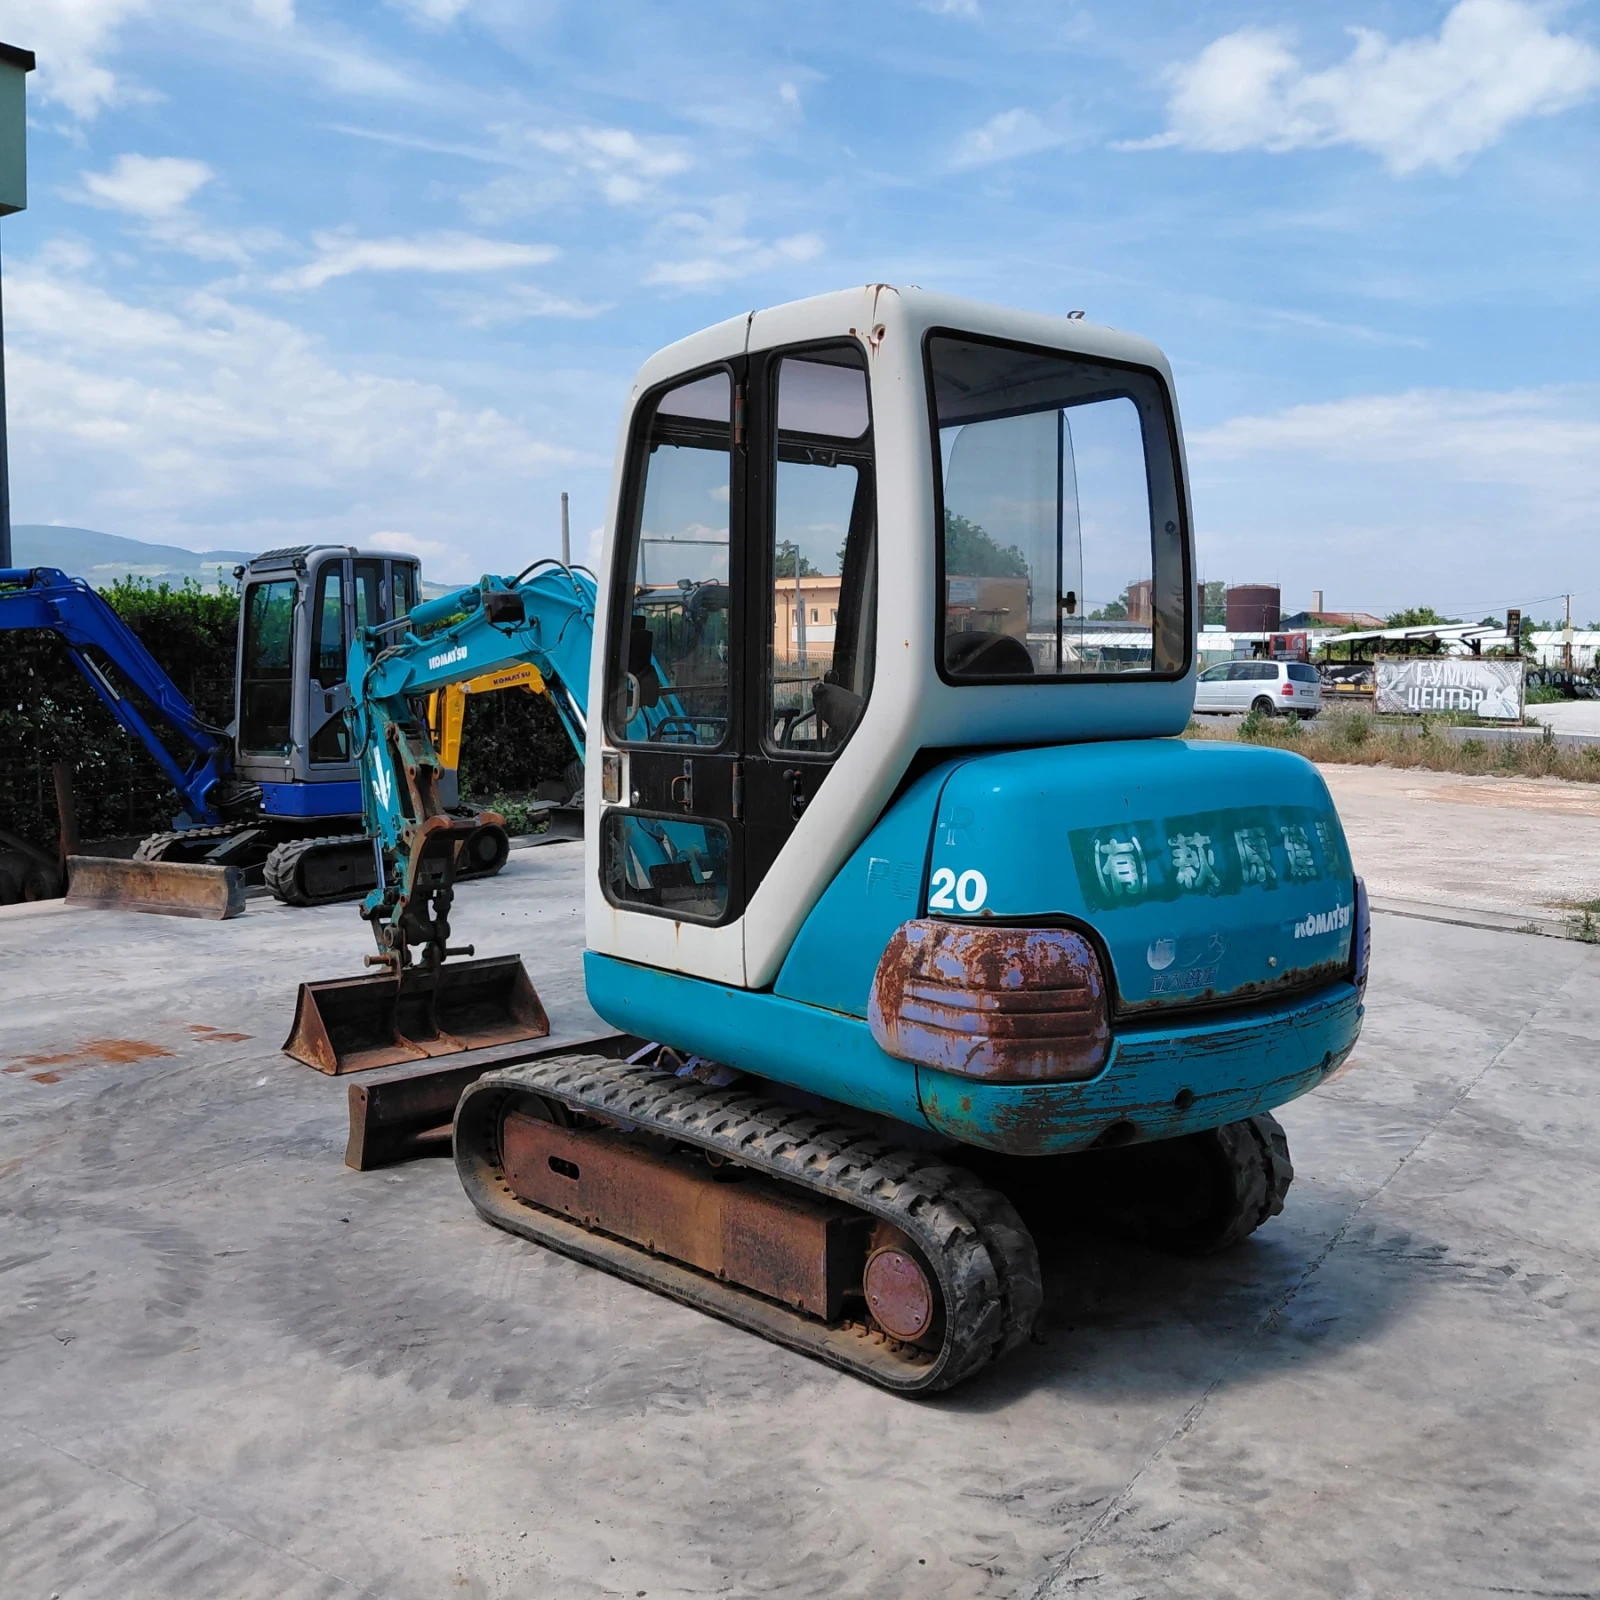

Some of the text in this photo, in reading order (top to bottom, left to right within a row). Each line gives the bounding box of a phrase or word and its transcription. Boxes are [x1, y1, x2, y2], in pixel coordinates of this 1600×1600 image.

[429, 646, 467, 670] KOMATSU
[493, 671, 531, 685] KOMATSU
[1408, 687, 1484, 711] ЦЕНТЪР
[929, 867, 988, 912] 20
[1294, 903, 1350, 939] KOMATSU
